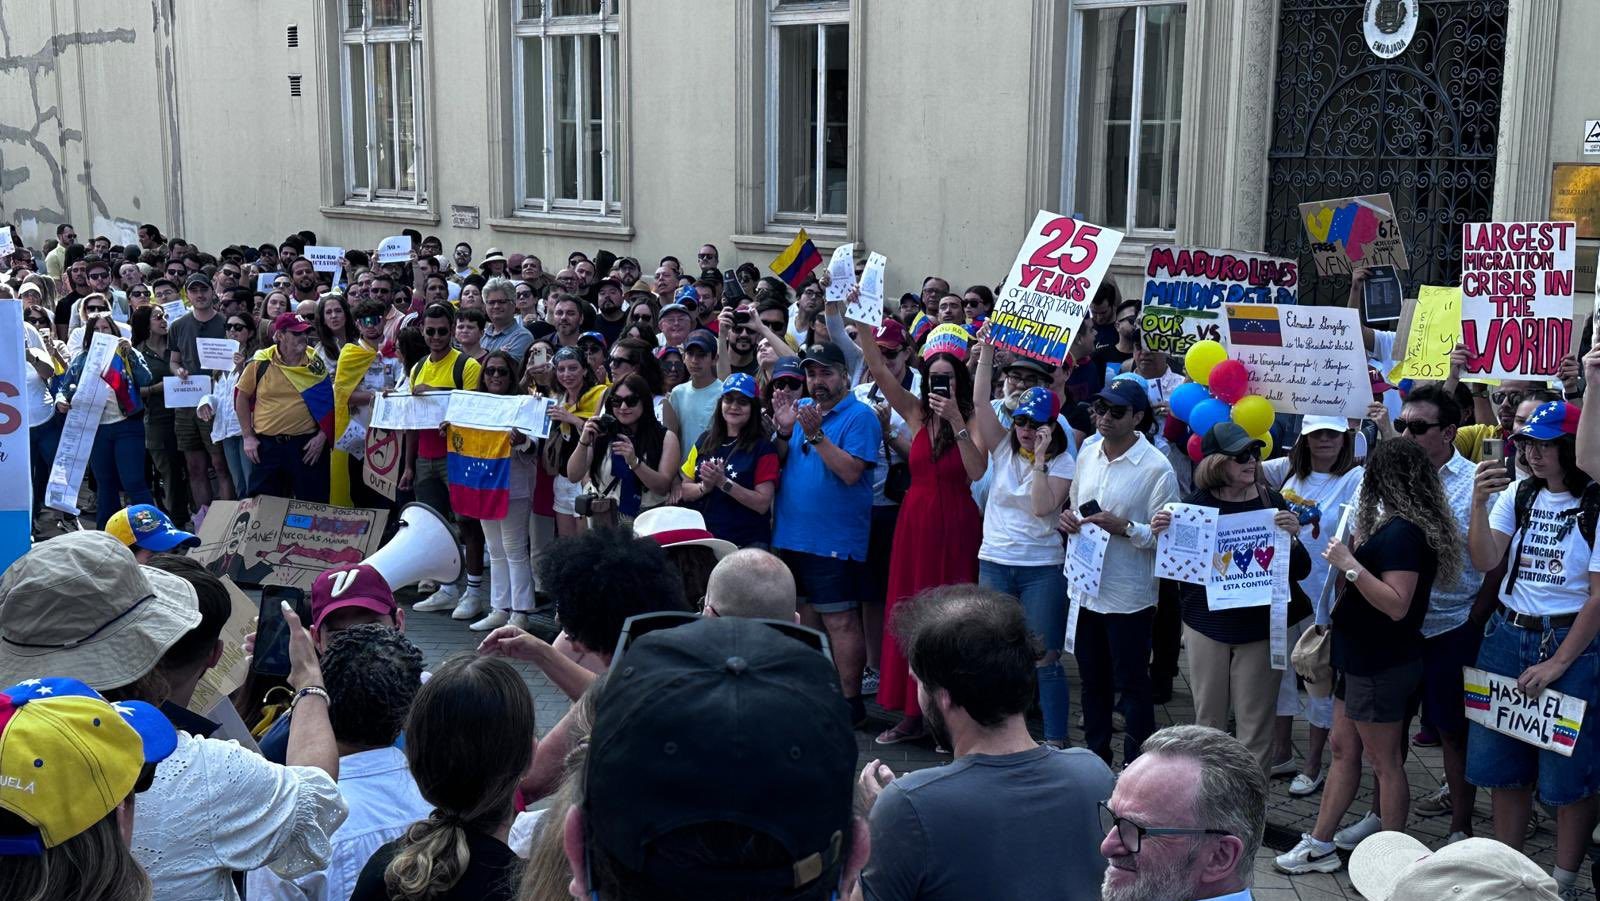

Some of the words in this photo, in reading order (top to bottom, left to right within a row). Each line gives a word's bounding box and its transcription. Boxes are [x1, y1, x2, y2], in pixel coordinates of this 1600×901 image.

[1372, 39, 1406, 54] EMBAJADA
[1029, 217, 1102, 275] 25
[1464, 223, 1575, 251] LARGEST
[1148, 248, 1248, 281] MADURO
[1464, 251, 1554, 270] MIGRATION
[1019, 264, 1091, 302] YEARS
[1463, 271, 1536, 297] CRISIS
[1544, 270, 1572, 296] IN
[1144, 280, 1227, 311] MILLIONS
[1489, 296, 1536, 317] THE
[1000, 299, 1035, 320] POWER
[1035, 309, 1049, 322] IN
[986, 309, 1071, 367] VENEZUELA
[1141, 314, 1184, 334] OUR
[1197, 324, 1221, 342] VS
[1143, 333, 1196, 355] VOTES
[1462, 317, 1573, 375] WORLD!
[281, 532, 322, 542] NICOLAS
[1247, 525, 1267, 533] MARIA
[1531, 533, 1549, 543] THIS
[1549, 536, 1558, 546] IS
[1522, 545, 1565, 560] EMOCRACY
[1535, 559, 1546, 570] VS
[1223, 583, 1241, 591] ESTA
[1225, 571, 1254, 581] MUNDO
[1519, 570, 1566, 585] CTATORSHIP
[1543, 697, 1563, 720] EL
[1497, 706, 1549, 744] FINAL
